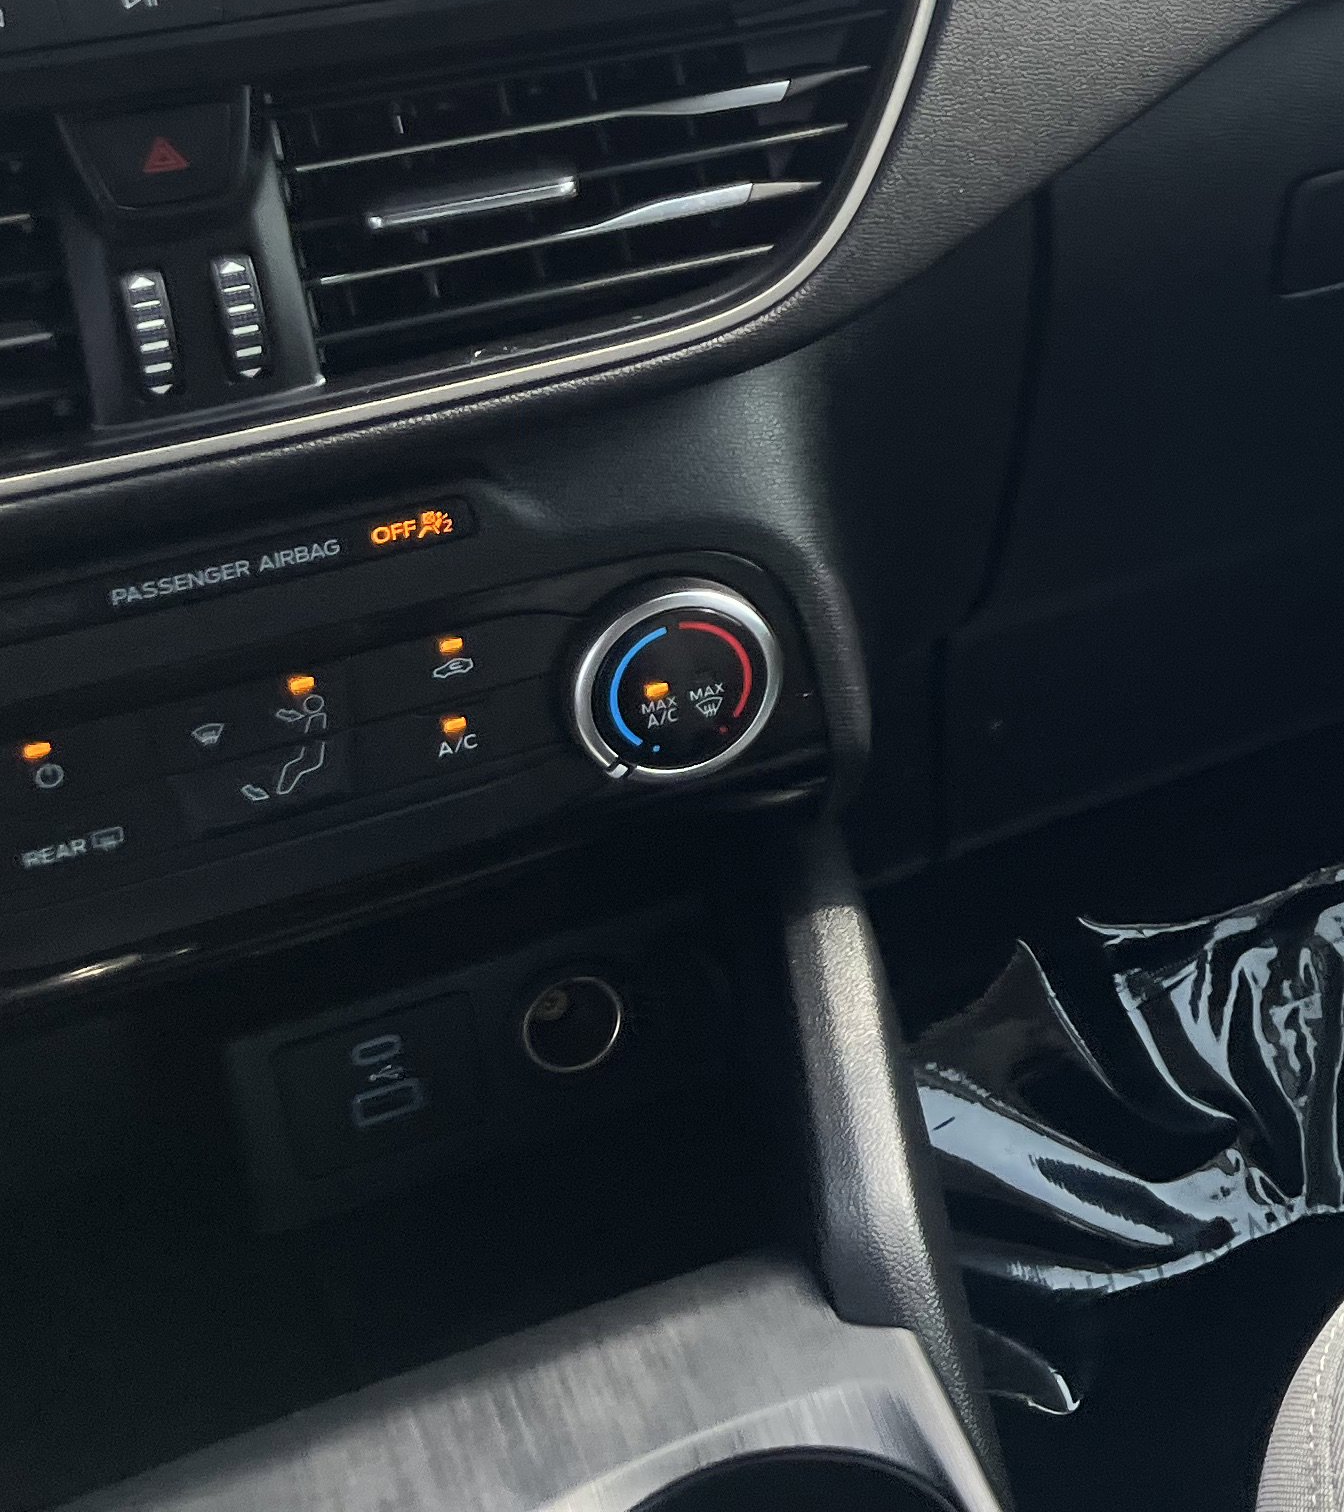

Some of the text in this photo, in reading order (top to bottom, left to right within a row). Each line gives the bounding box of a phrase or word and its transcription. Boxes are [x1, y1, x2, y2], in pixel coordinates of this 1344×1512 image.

[371, 519, 416, 545] OFF
[110, 538, 341, 606] PASSENGER AIRBAG
[689, 682, 725, 701] MAX
[641, 695, 679, 715] MAX
[647, 707, 679, 729] A/C
[437, 733, 479, 758] A/C
[22, 838, 87, 868] REAR
